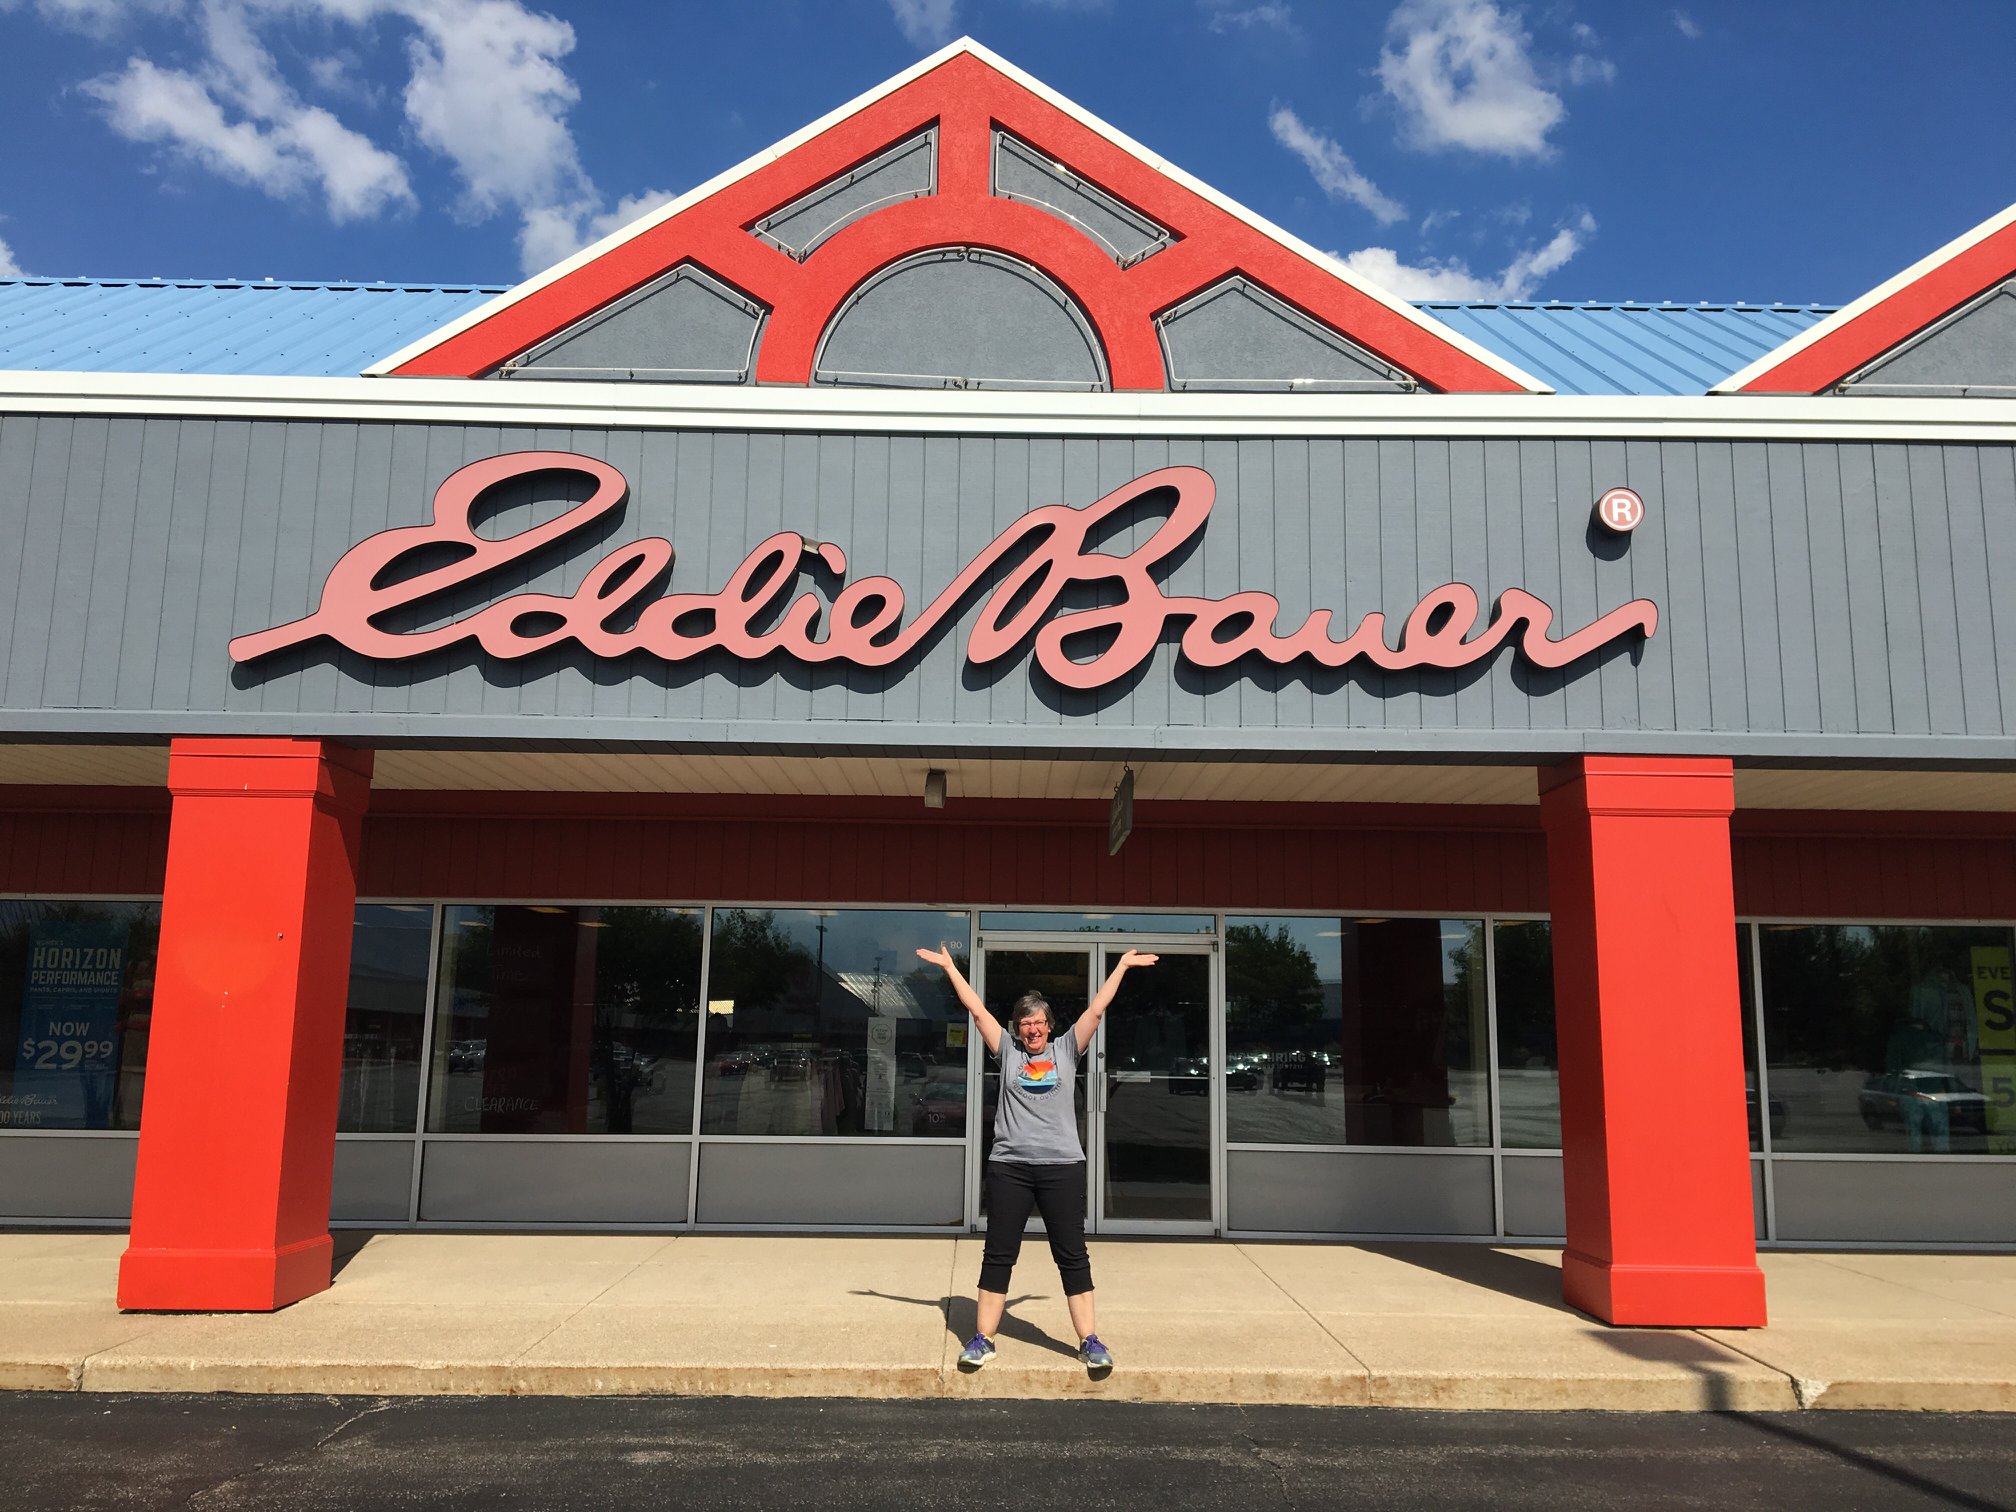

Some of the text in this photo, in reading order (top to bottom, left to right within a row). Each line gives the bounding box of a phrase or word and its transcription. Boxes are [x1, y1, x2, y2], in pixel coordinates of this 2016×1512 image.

[228, 450, 905, 667] Eddie
[915, 465, 1659, 689] Bauer
[32, 947, 122, 970] HORIZON
[30, 970, 120, 986] PERFORMANCE
[1977, 966, 2010, 980] EVE
[49, 1022, 90, 1036] NOW
[464, 1096, 540, 1113] CLEARANCE
[13, 1111, 41, 1124] YEARS
